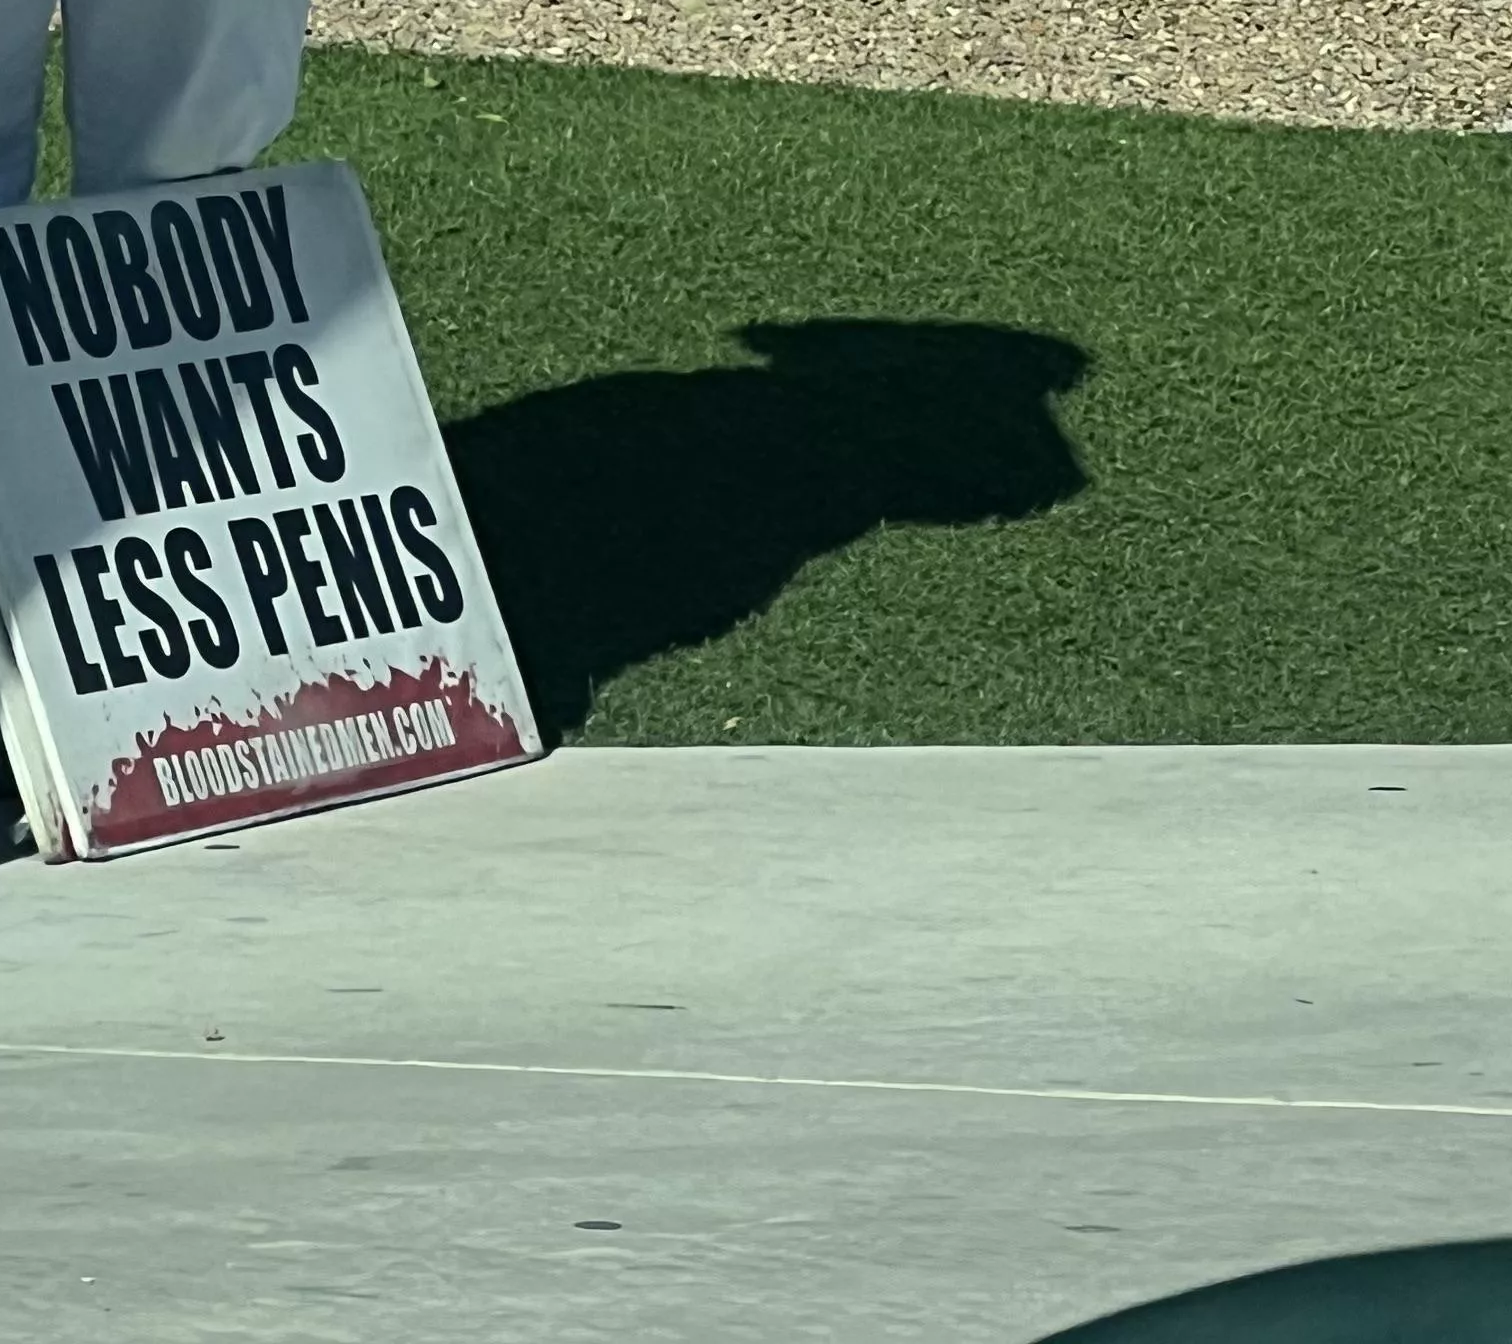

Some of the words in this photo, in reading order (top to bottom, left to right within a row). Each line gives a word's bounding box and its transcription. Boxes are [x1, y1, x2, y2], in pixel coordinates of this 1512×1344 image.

[51, 343, 346, 522] WANTS
[33, 526, 240, 696] LESS
[227, 485, 465, 656] PENIS
[152, 698, 456, 807] BLOODSTAINEDMEN.COM
